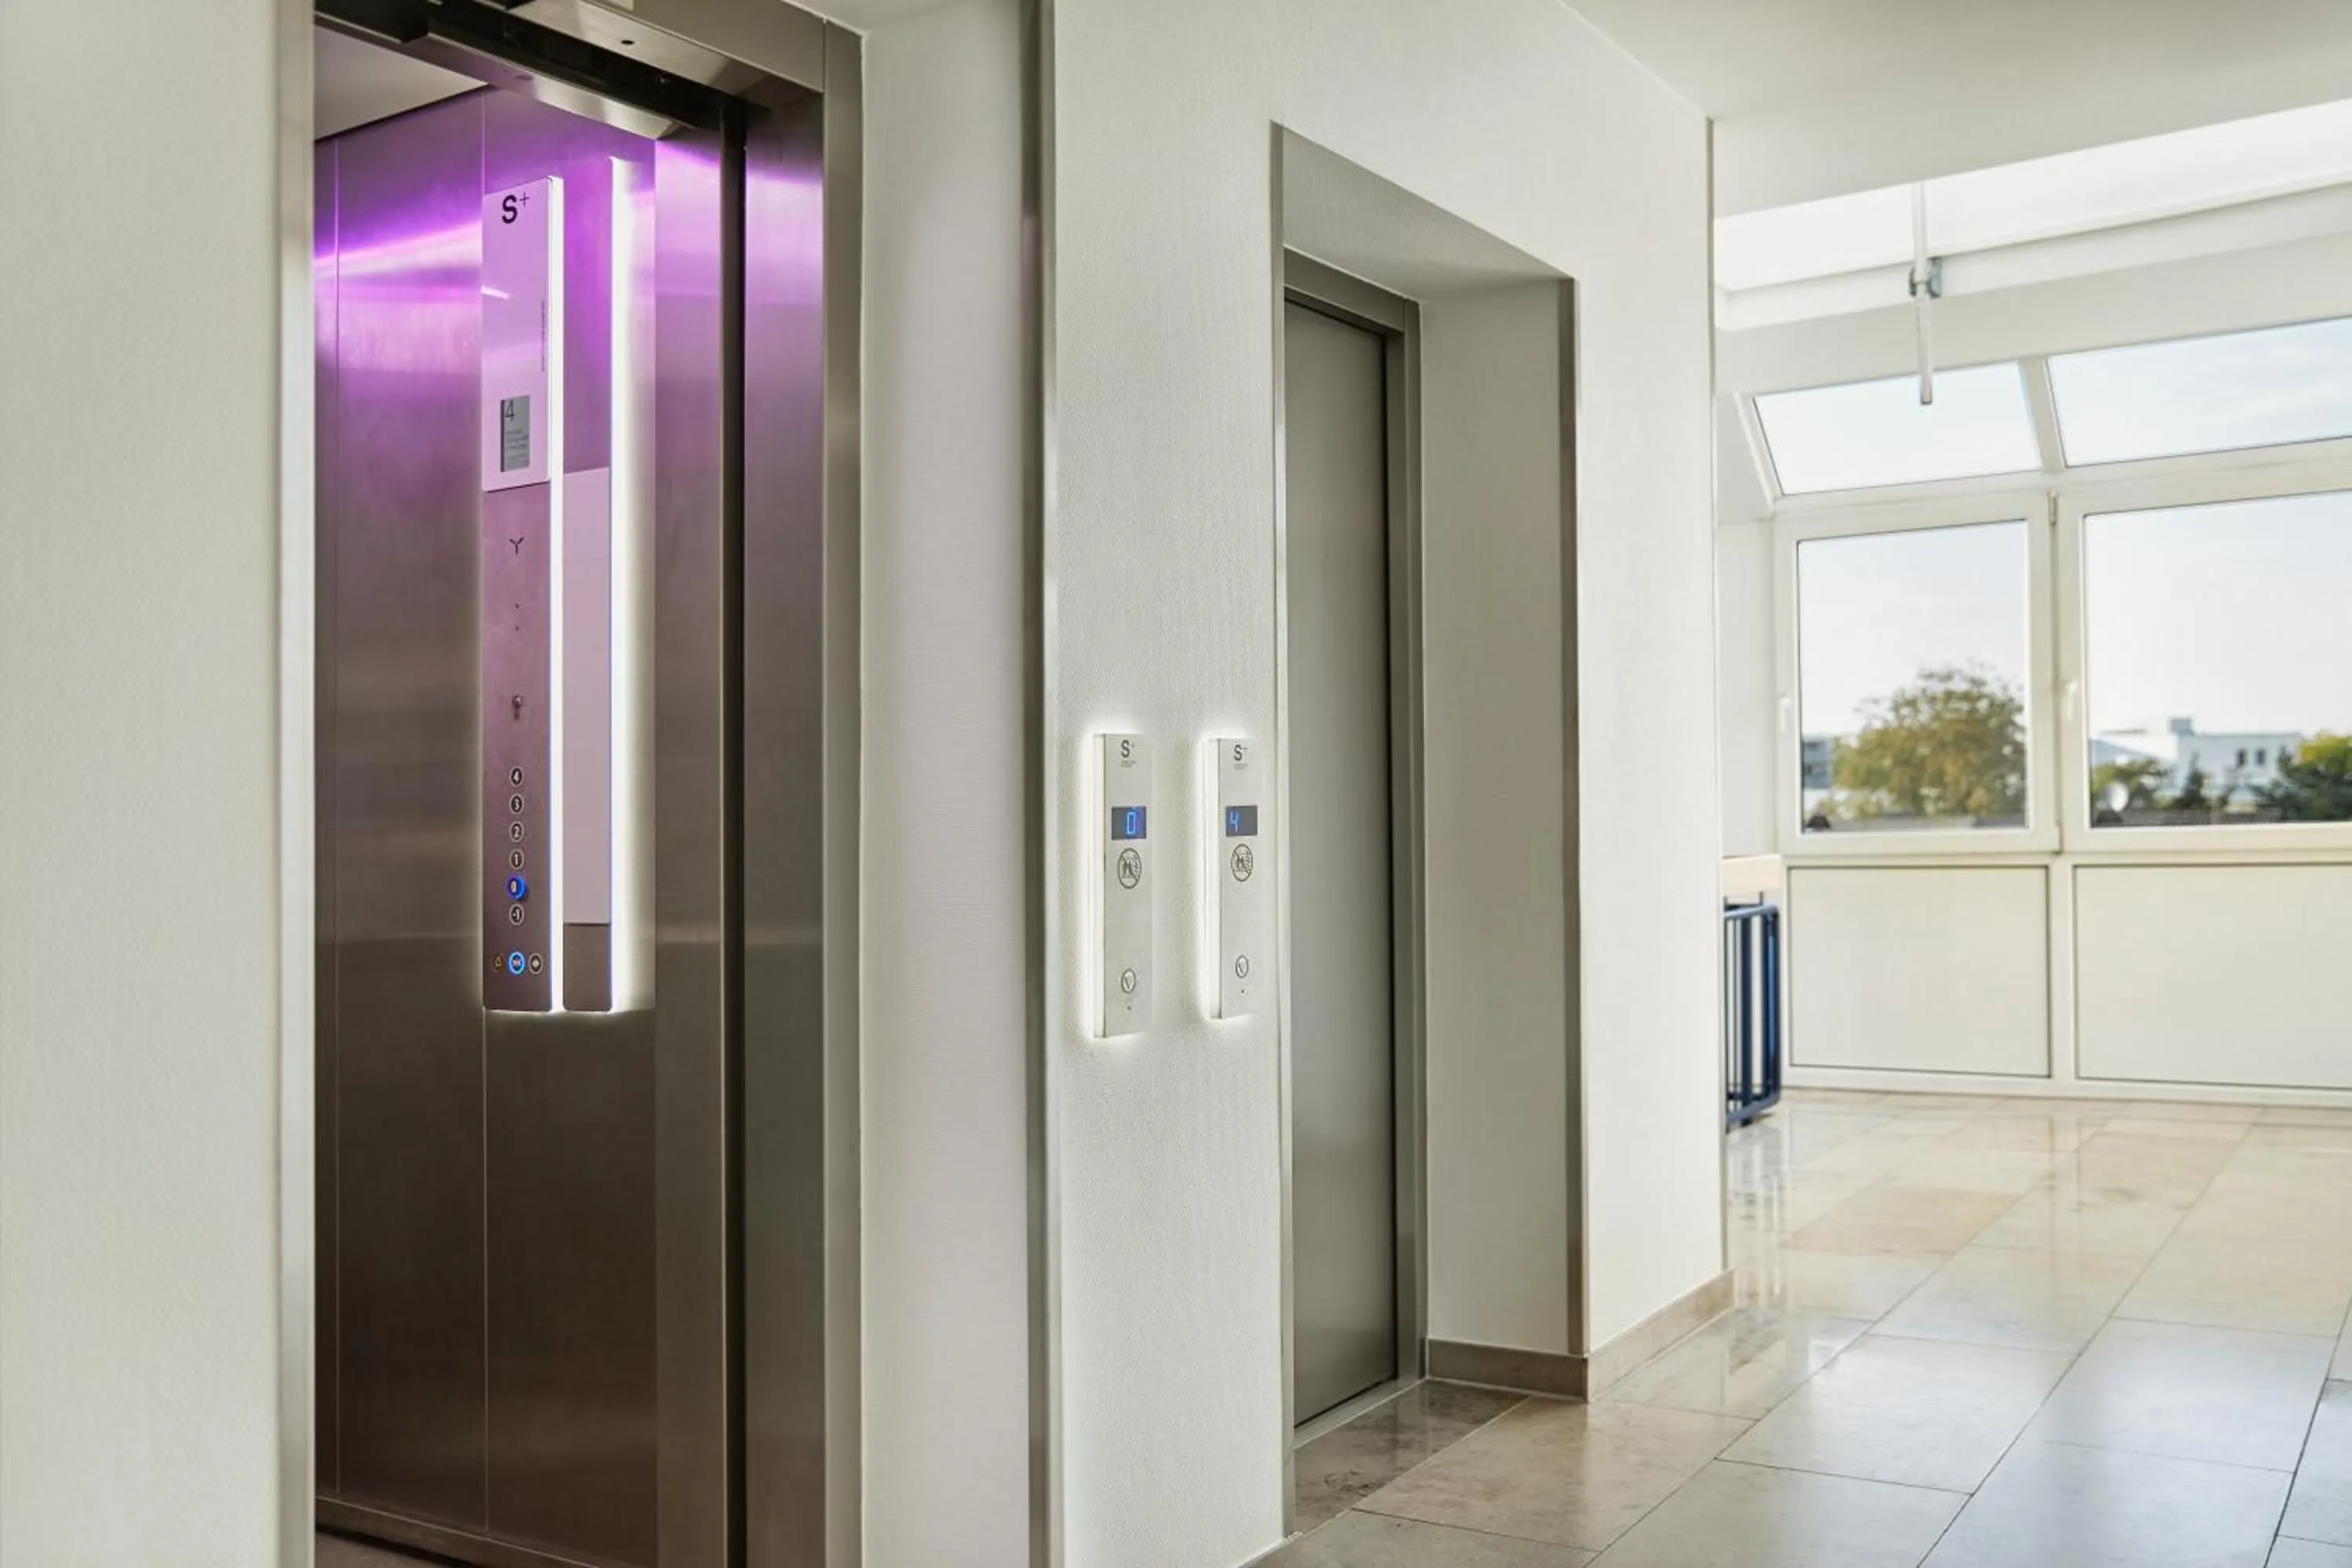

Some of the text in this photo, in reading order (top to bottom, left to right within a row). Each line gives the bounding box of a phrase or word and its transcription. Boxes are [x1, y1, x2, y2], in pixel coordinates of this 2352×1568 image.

[505, 400, 514, 421] 4
[513, 771, 519, 782] 4
[514, 798, 520, 810] 3
[1127, 811, 1135, 835] 0
[1229, 810, 1240, 832] 4
[514, 826, 520, 838] 2
